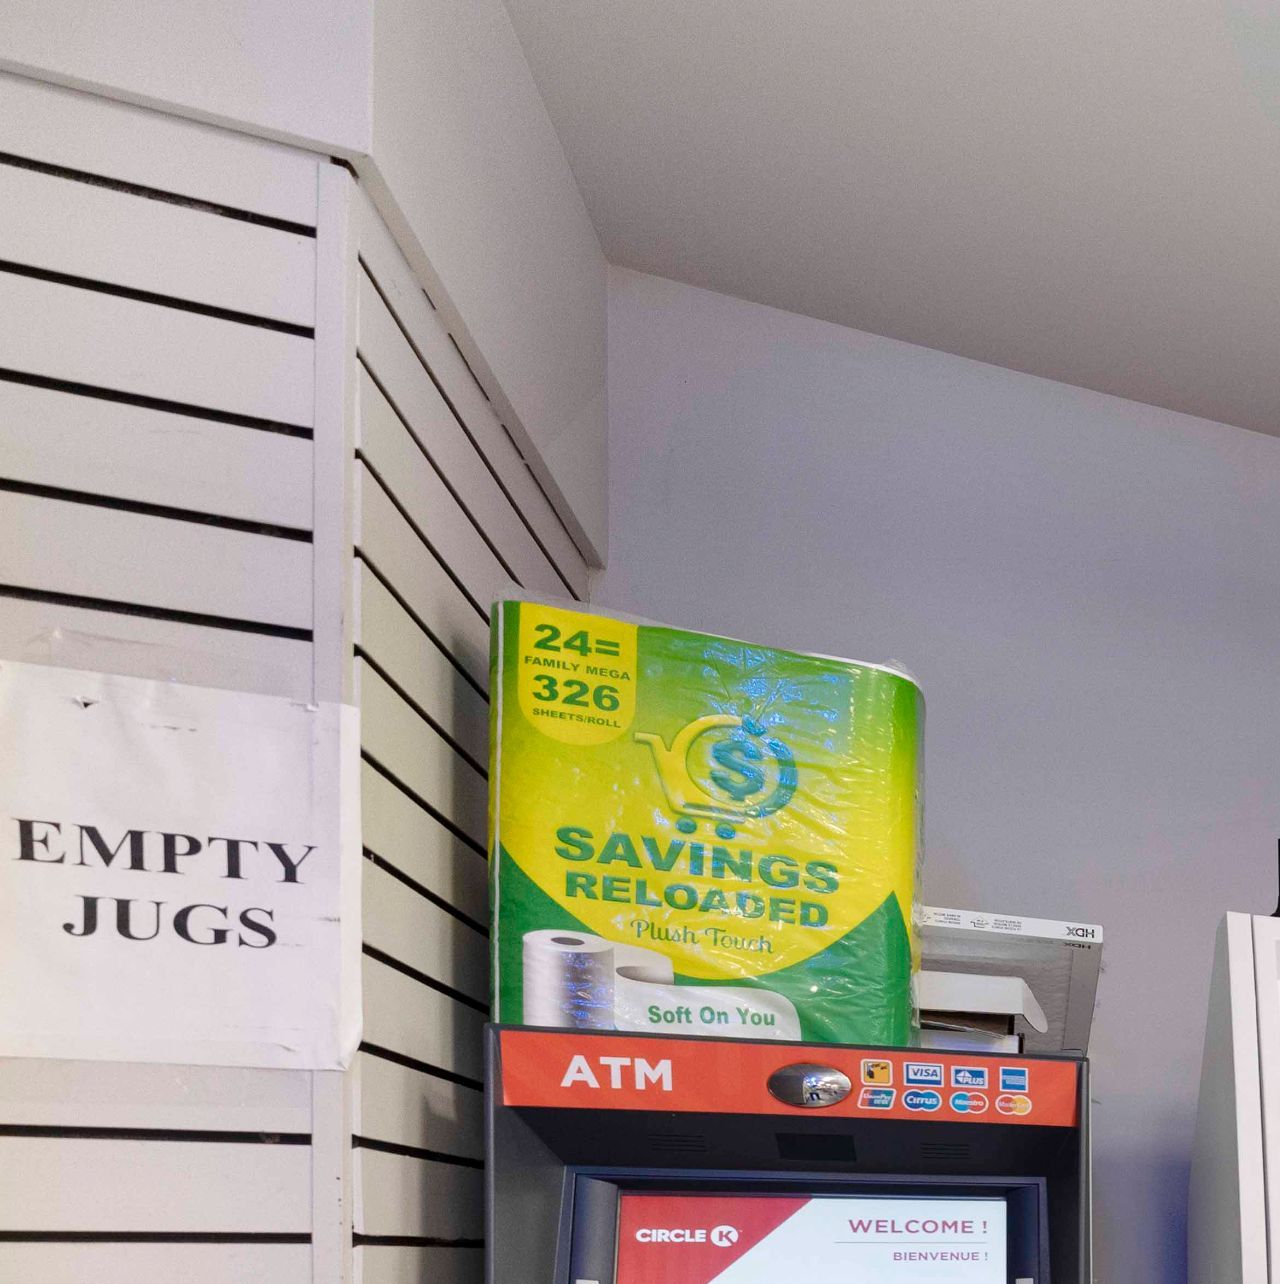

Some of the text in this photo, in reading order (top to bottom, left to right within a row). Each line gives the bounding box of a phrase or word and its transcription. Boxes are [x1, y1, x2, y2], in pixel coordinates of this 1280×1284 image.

[523, 655, 631, 681] FAMILY MEGA
[532, 674, 620, 712] 326
[531, 707, 622, 729] SHEETS/ROLL
[12, 818, 320, 885] EMPTY
[554, 826, 840, 894] SAVINGS
[565, 870, 830, 928] RELOADED
[62, 895, 279, 949] JUGS
[630, 919, 774, 954] Plush Touch
[648, 1005, 776, 1026] Soft On You
[560, 1055, 674, 1093] ATM
[911, 1067, 939, 1079] VISA
[963, 1076, 985, 1086] PLUS
[906, 1095, 937, 1106] Cirrus
[635, 1228, 707, 1244] CIRCLE
[848, 1218, 975, 1235] WELCOME
[892, 1250, 980, 1262] BIENVENUE
